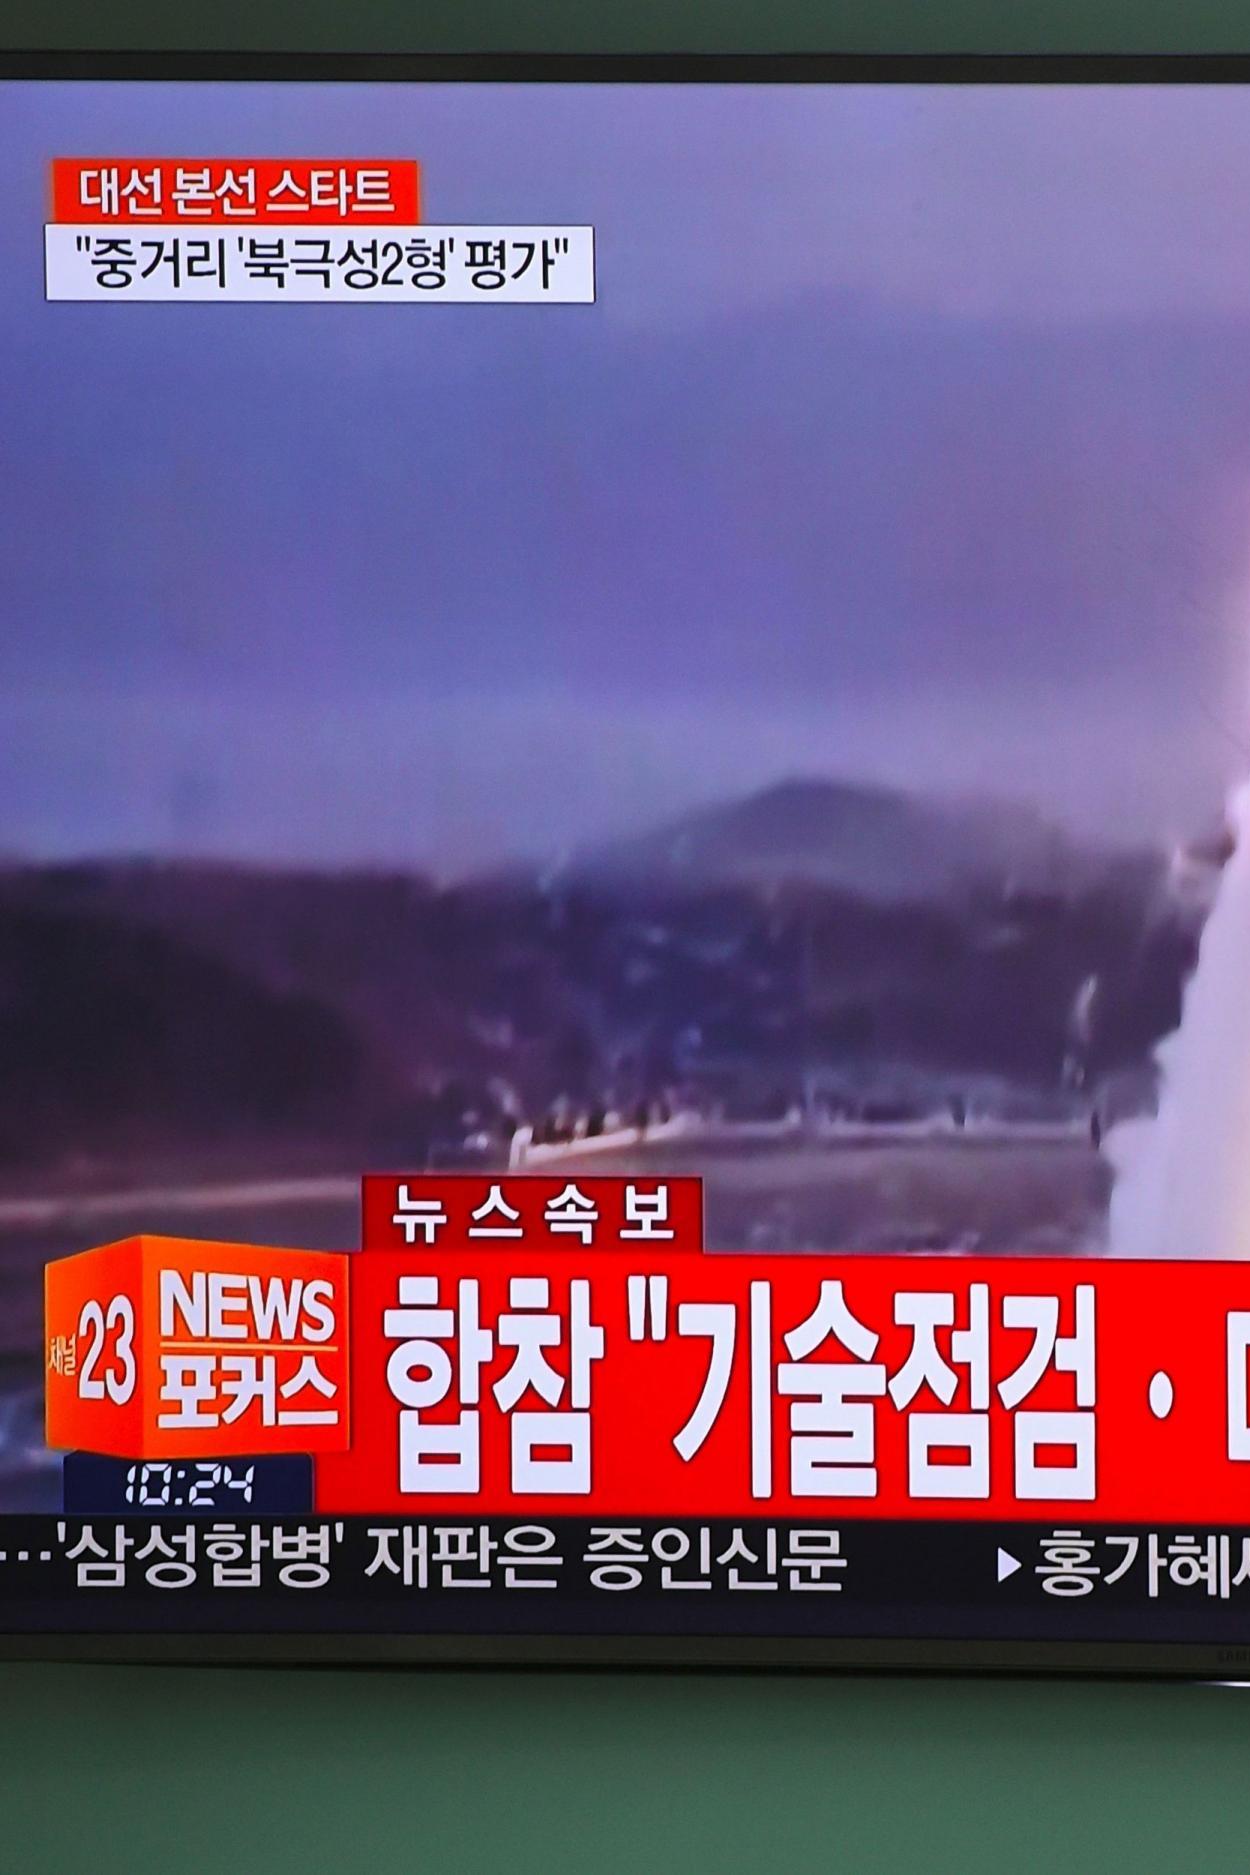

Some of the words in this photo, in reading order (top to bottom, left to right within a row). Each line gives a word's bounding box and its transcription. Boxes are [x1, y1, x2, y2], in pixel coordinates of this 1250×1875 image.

[79, 167, 162, 216] 대선
[171, 168, 257, 217] 본선
[266, 168, 395, 217] 스타트
[76, 235, 226, 290] "중거리
[238, 235, 455, 291] '북극성2형'
[464, 236, 569, 291] 평가"
[159, 1269, 335, 1343] NEWS
[48, 1333, 76, 1377] 채널
[78, 1294, 136, 1405] 23
[158, 1355, 339, 1429] 포커스
[384, 1276, 604, 1494] 합참
[627, 1275, 1096, 1501] "기술점검
[125, 1463, 255, 1506] 10:24
[364, 1525, 564, 1589] 재판은
[582, 1526, 848, 1591] 증인신문
